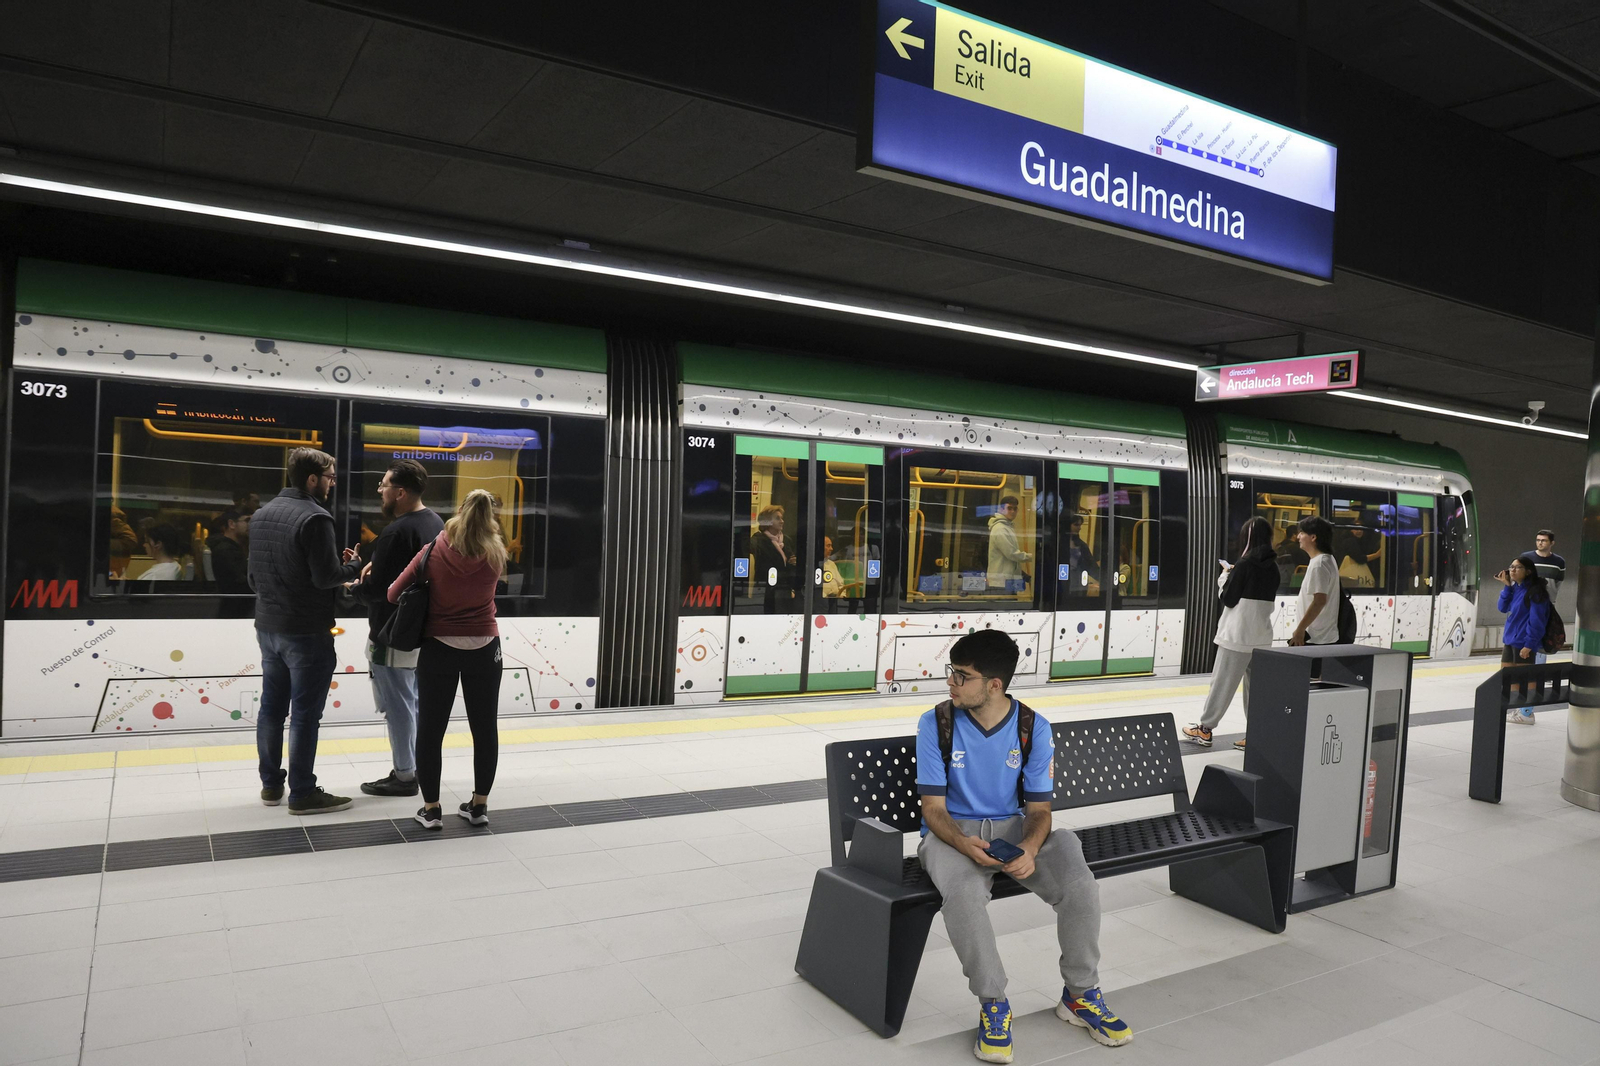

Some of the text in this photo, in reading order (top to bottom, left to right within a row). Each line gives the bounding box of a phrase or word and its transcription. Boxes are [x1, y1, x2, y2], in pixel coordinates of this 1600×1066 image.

[957, 29, 1032, 79] Salida
[954, 64, 985, 91] Exit
[1020, 141, 1246, 240] Guadalmedina
[1226, 371, 1314, 391] Andalucía Tech
[1229, 367, 1256, 377] dirección
[21, 380, 68, 398] 3073
[687, 436, 715, 449] 3074
[1229, 480, 1244, 490] 3075
[40, 625, 117, 676] Puesto de Control
[131, 688, 154, 703] Tech
